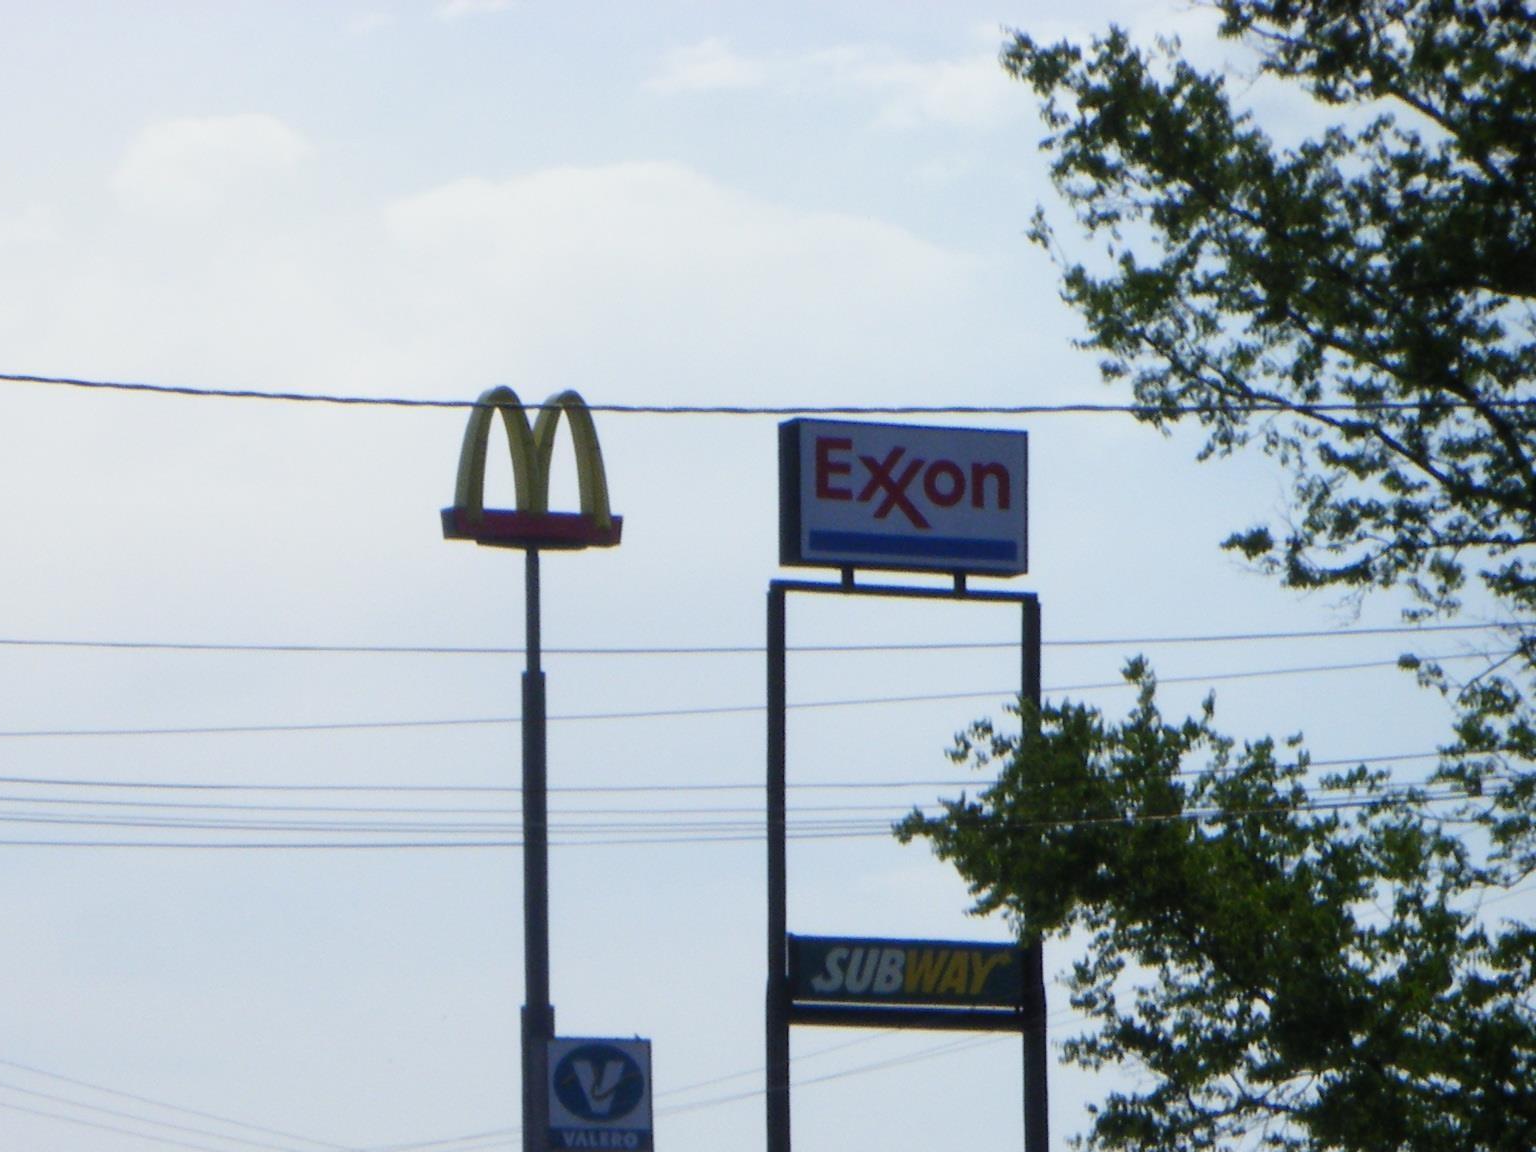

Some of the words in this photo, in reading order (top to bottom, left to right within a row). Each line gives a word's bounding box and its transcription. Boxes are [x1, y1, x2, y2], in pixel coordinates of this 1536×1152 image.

[814, 436, 1012, 530] Exxon
[810, 946, 1011, 996] SUBWAY
[562, 1130, 639, 1150] VALERO
